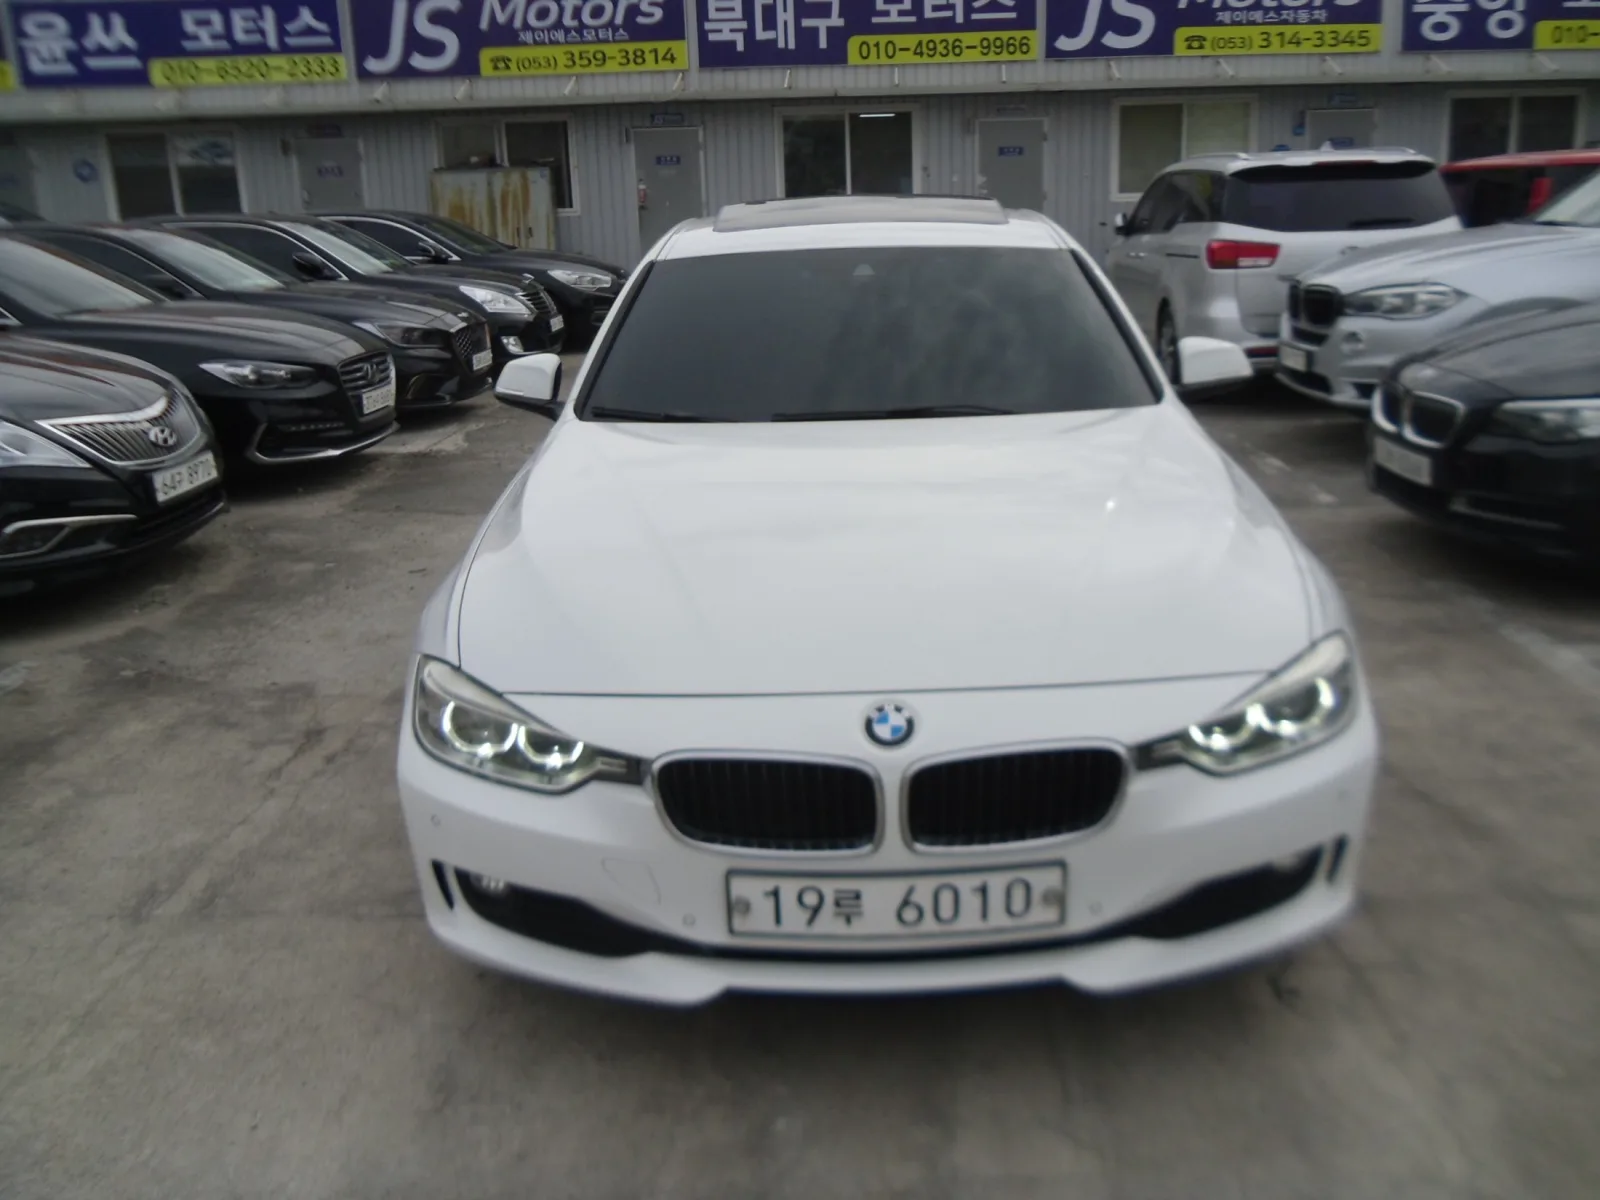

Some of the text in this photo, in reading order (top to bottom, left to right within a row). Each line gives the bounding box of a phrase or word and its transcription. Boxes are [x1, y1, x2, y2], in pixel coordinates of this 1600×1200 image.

[180, 5, 335, 51] 모터스
[704, 0, 845, 52] 북대구
[1215, 9, 1328, 24] 제이에스자동차
[363, 0, 665, 74] JS Motors
[518, 27, 630, 45] 제이에스모터스
[858, 36, 1031, 60] 010-4936-9966
[1211, 30, 1371, 51] (053) 314-3345
[516, 47, 677, 71] (053) 359-3814
[763, 876, 1033, 928] 19루 6010
